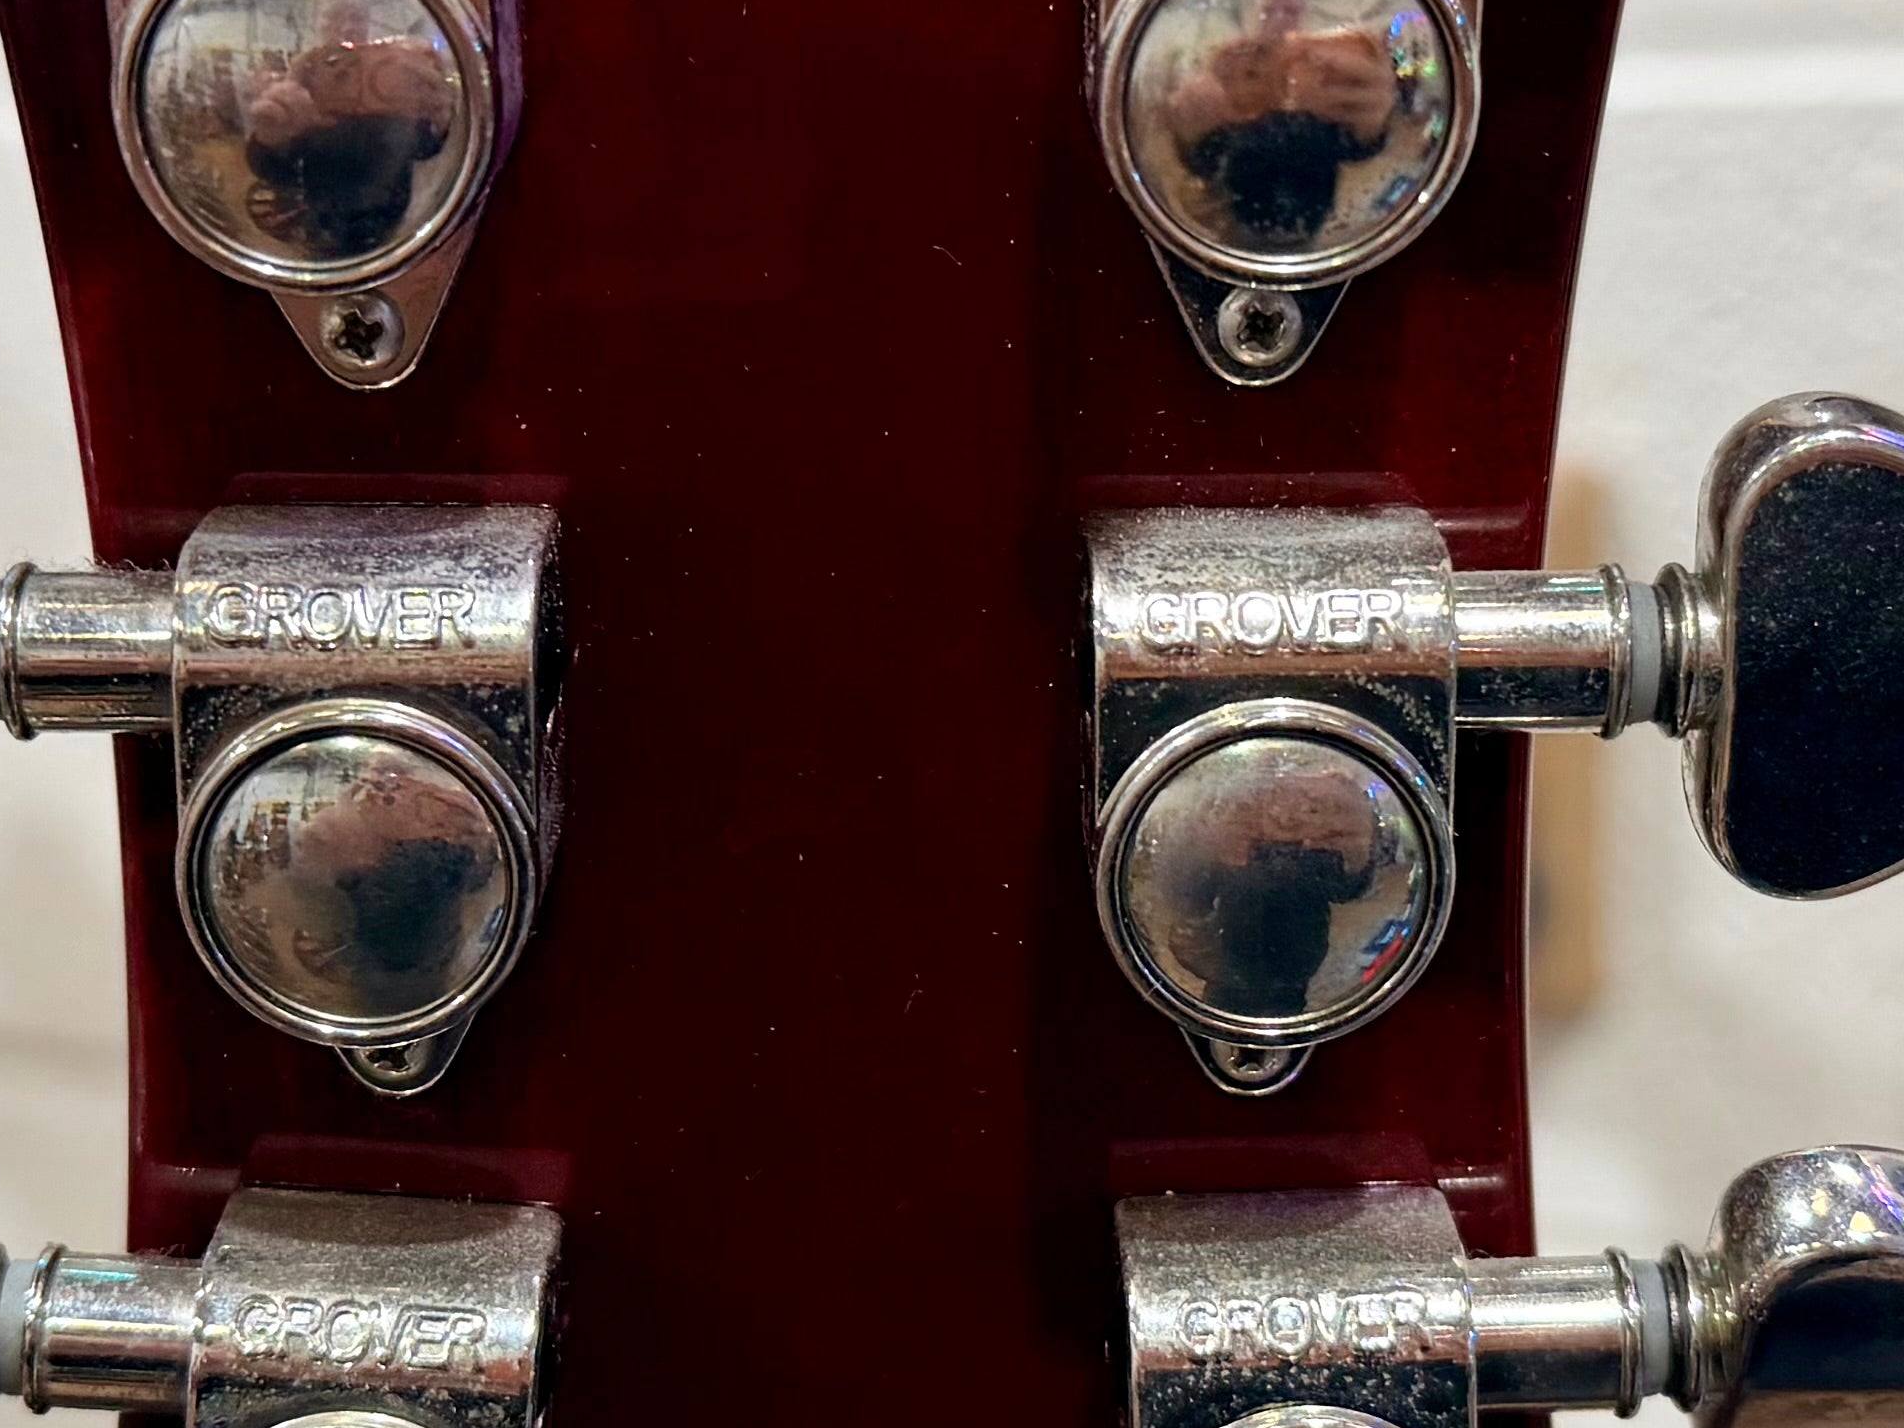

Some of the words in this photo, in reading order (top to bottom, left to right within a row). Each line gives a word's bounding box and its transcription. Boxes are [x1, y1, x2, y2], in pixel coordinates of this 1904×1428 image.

[207, 582, 477, 650] GROVER
[1140, 588, 1404, 655] GROVER
[234, 1293, 488, 1370] GROVER
[1178, 1287, 1434, 1360] GROVER
